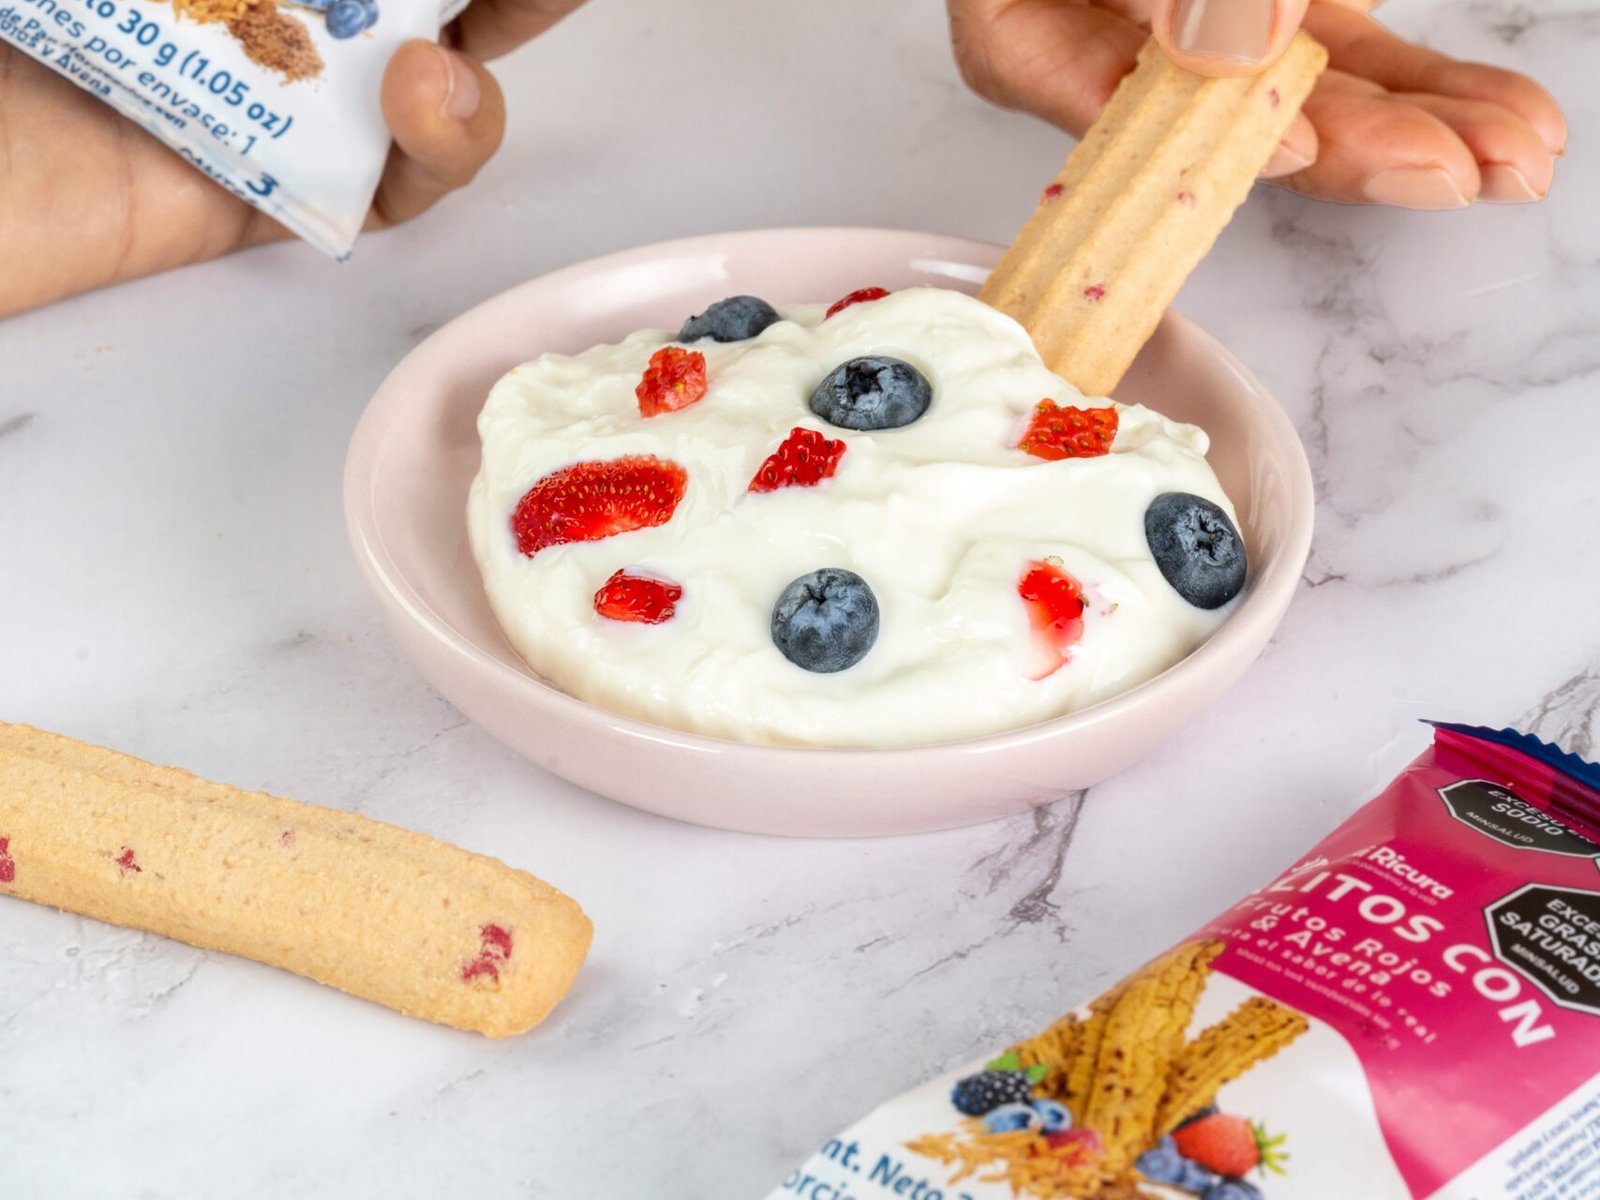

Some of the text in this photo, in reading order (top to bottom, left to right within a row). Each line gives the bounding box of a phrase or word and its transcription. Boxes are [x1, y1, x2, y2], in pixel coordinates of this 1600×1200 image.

[84, 35, 137, 70] por
[137, 70, 237, 146] envase:
[241, 136, 257, 156] 1
[116, 8, 160, 46] 30
[154, 42, 178, 67] g
[179, 50, 250, 106] (1.05
[247, 103, 293, 139] oz)
[1466, 811, 1533, 844] MINSALUD
[1491, 803, 1564, 836] SODIO
[1368, 846, 1454, 899] Ricura
[1254, 871, 1445, 943] LITOS
[1442, 943, 1556, 1048] CON
[1281, 950, 1337, 980] sabor
[1341, 978, 1367, 994] de
[1283, 929, 1391, 986] Avena
[1353, 938, 1452, 997] Rojos
[1499, 911, 1600, 987] SATURAD
[1510, 943, 1580, 994] MINSALUD
[869, 1153, 943, 1200] Neto
